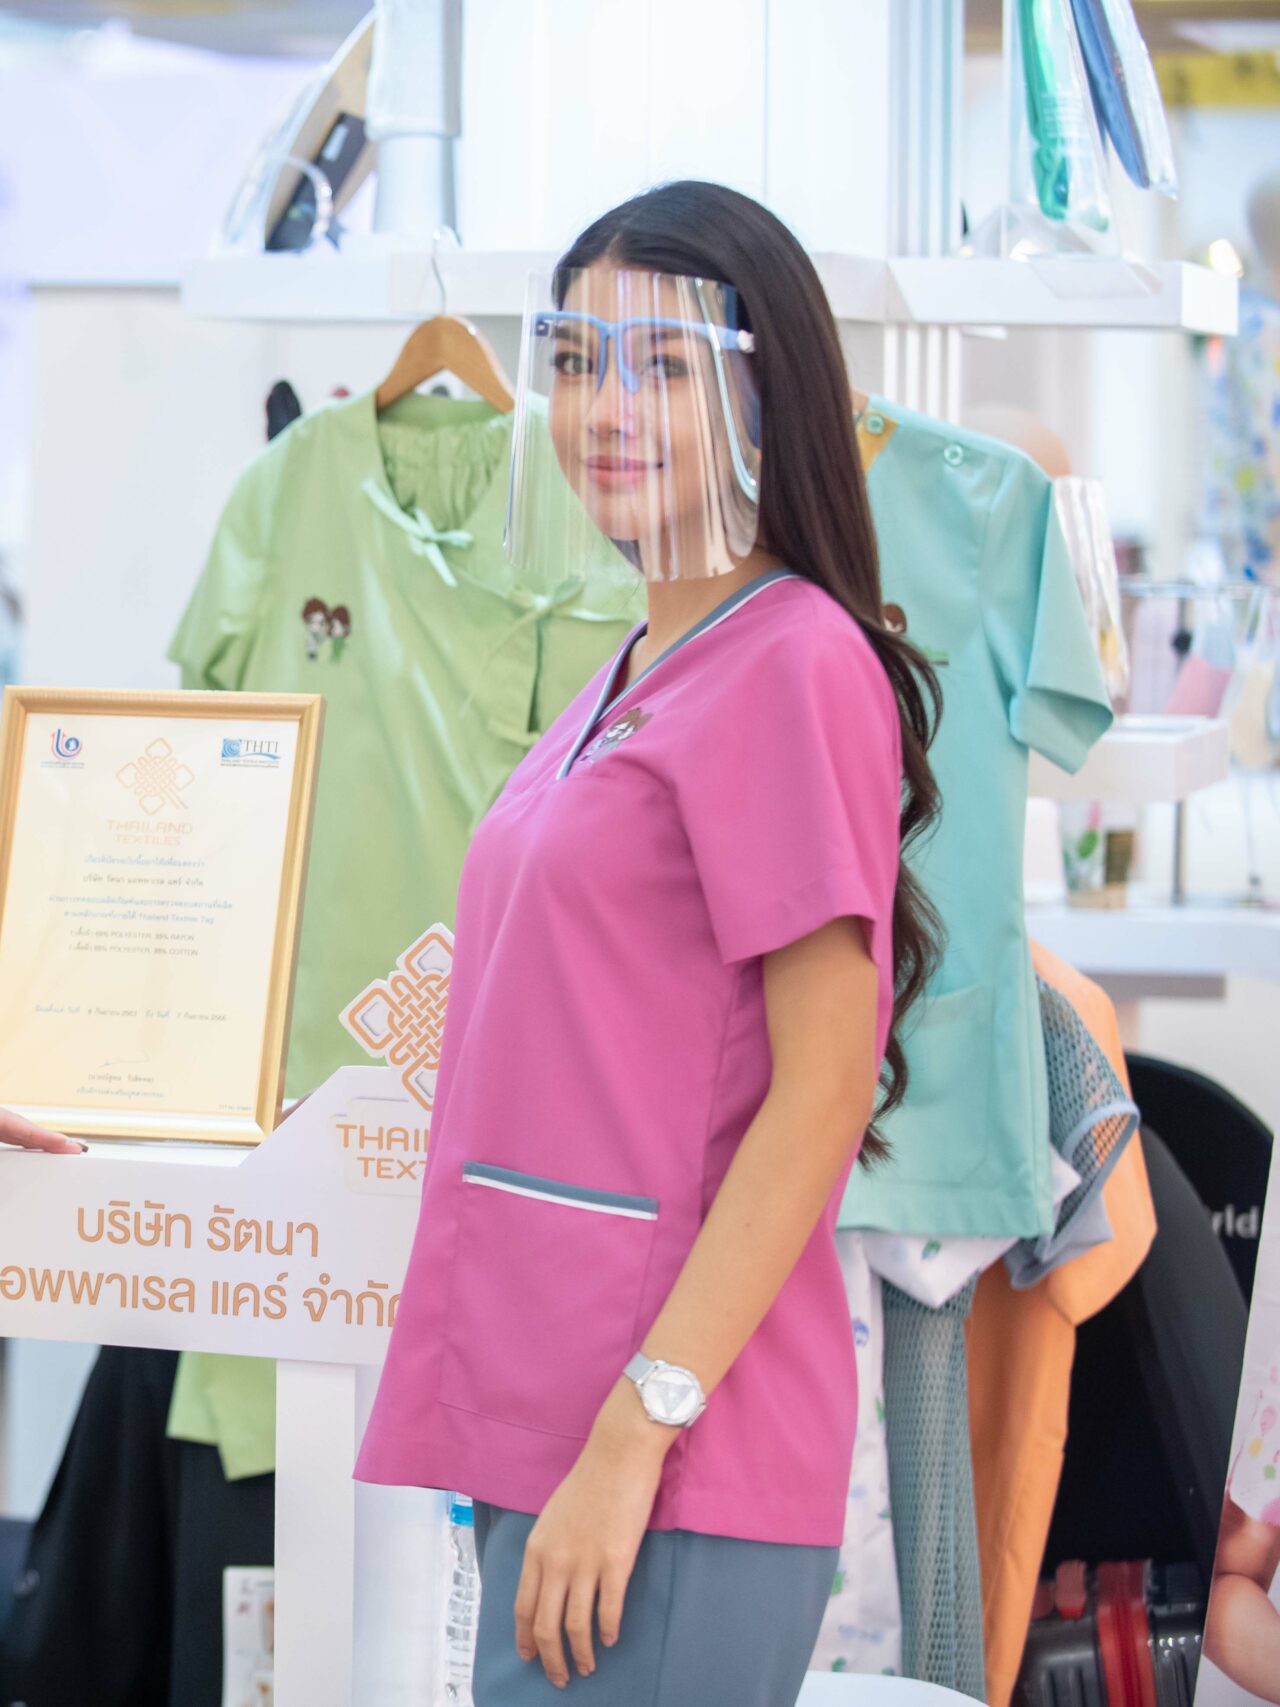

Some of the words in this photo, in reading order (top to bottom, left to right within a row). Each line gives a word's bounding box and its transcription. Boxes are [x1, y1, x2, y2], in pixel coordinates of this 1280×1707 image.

[106, 819, 192, 834] THAILAND
[113, 834, 181, 846] TEXTILES
[357, 1156, 426, 1180] TEX
[77, 1200, 192, 1249] บริษัท
[207, 1204, 319, 1257] รัตนา
[1211, 1203, 1260, 1239] rld
[211, 1272, 288, 1320] แคร์
